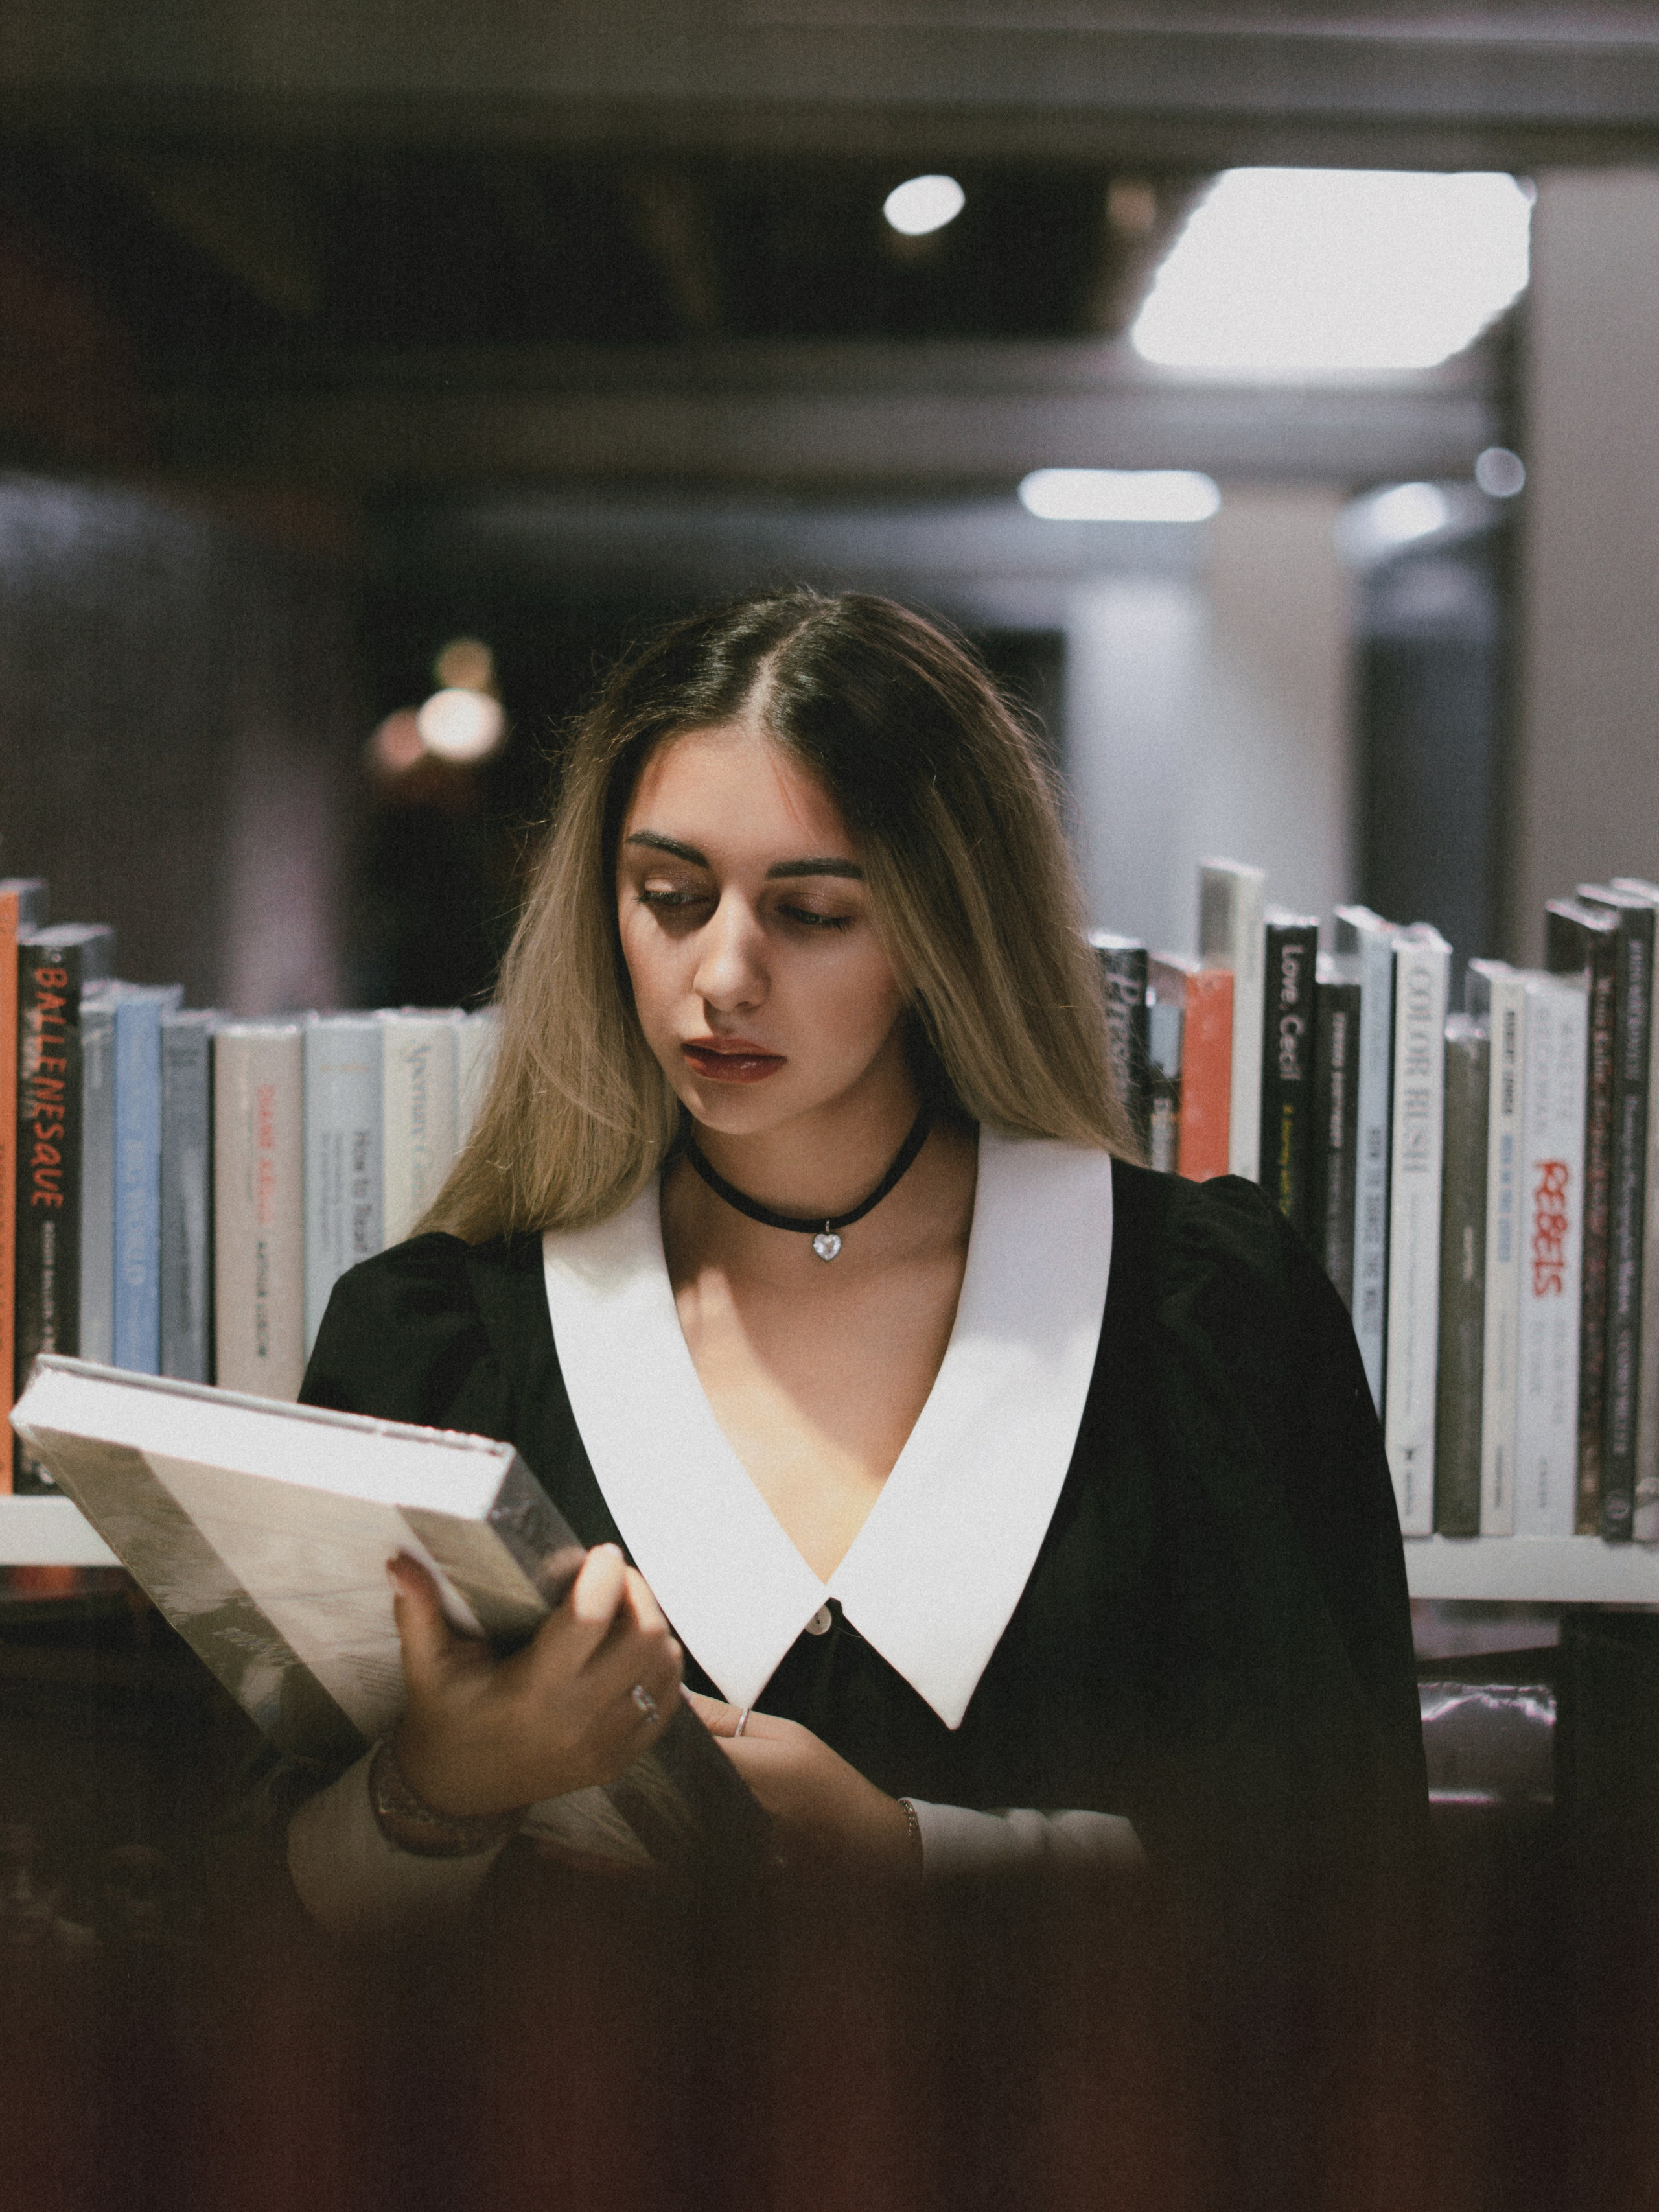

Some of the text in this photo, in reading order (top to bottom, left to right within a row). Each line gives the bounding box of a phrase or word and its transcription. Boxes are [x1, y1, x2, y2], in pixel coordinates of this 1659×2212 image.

[1280, 944, 1304, 1081] Love, Cecil
[1405, 966, 1432, 1077] COLOR
[31, 966, 67, 1209] BALLENESQUE
[1402, 1088, 1430, 1173] RUSH
[1531, 1159, 1568, 1298] REBELS
